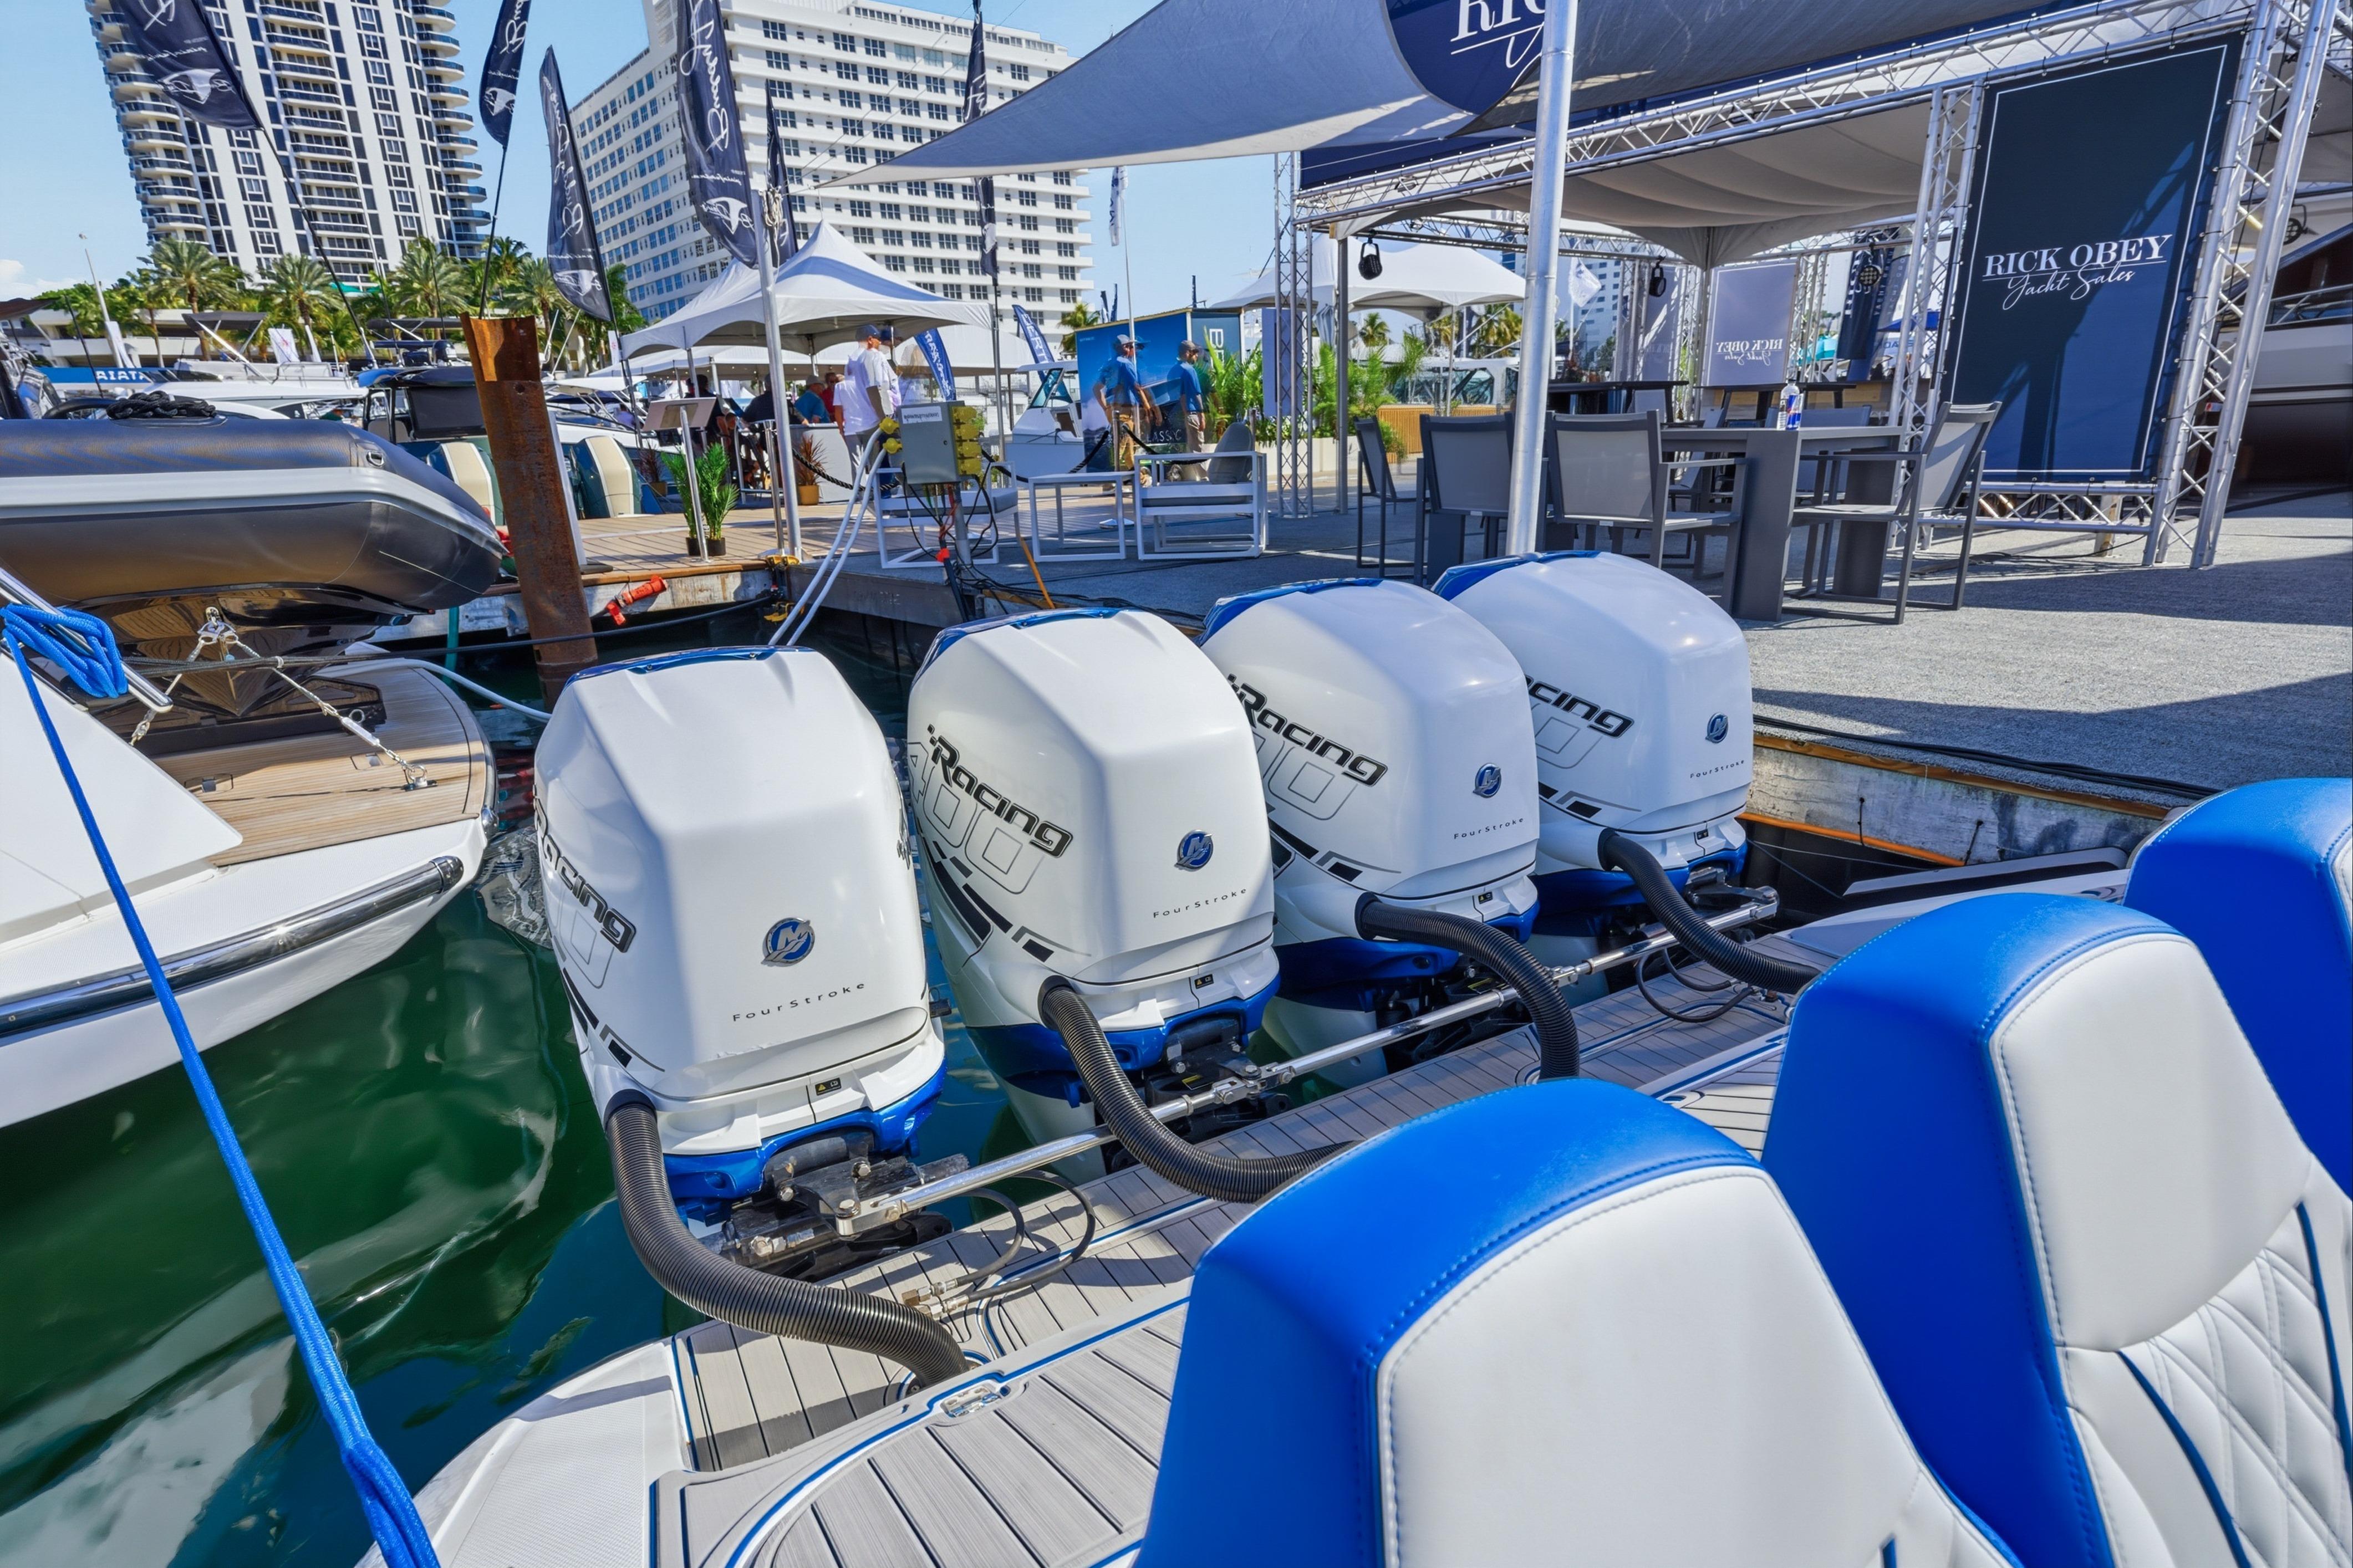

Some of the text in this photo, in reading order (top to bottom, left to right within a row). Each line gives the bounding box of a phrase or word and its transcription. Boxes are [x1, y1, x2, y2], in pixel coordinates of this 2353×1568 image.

[1982, 234, 2173, 277] RICK OBEY
[2003, 262, 2135, 310] Yacht Sales
[1237, 683, 1388, 788] Racing
[1690, 760, 1744, 778] FourStroke
[931, 736, 1073, 859] Racing
[1454, 818, 1524, 840] FourStroke
[1153, 888, 1246, 918] FourStroke
[732, 983, 865, 1022] FourStroke
